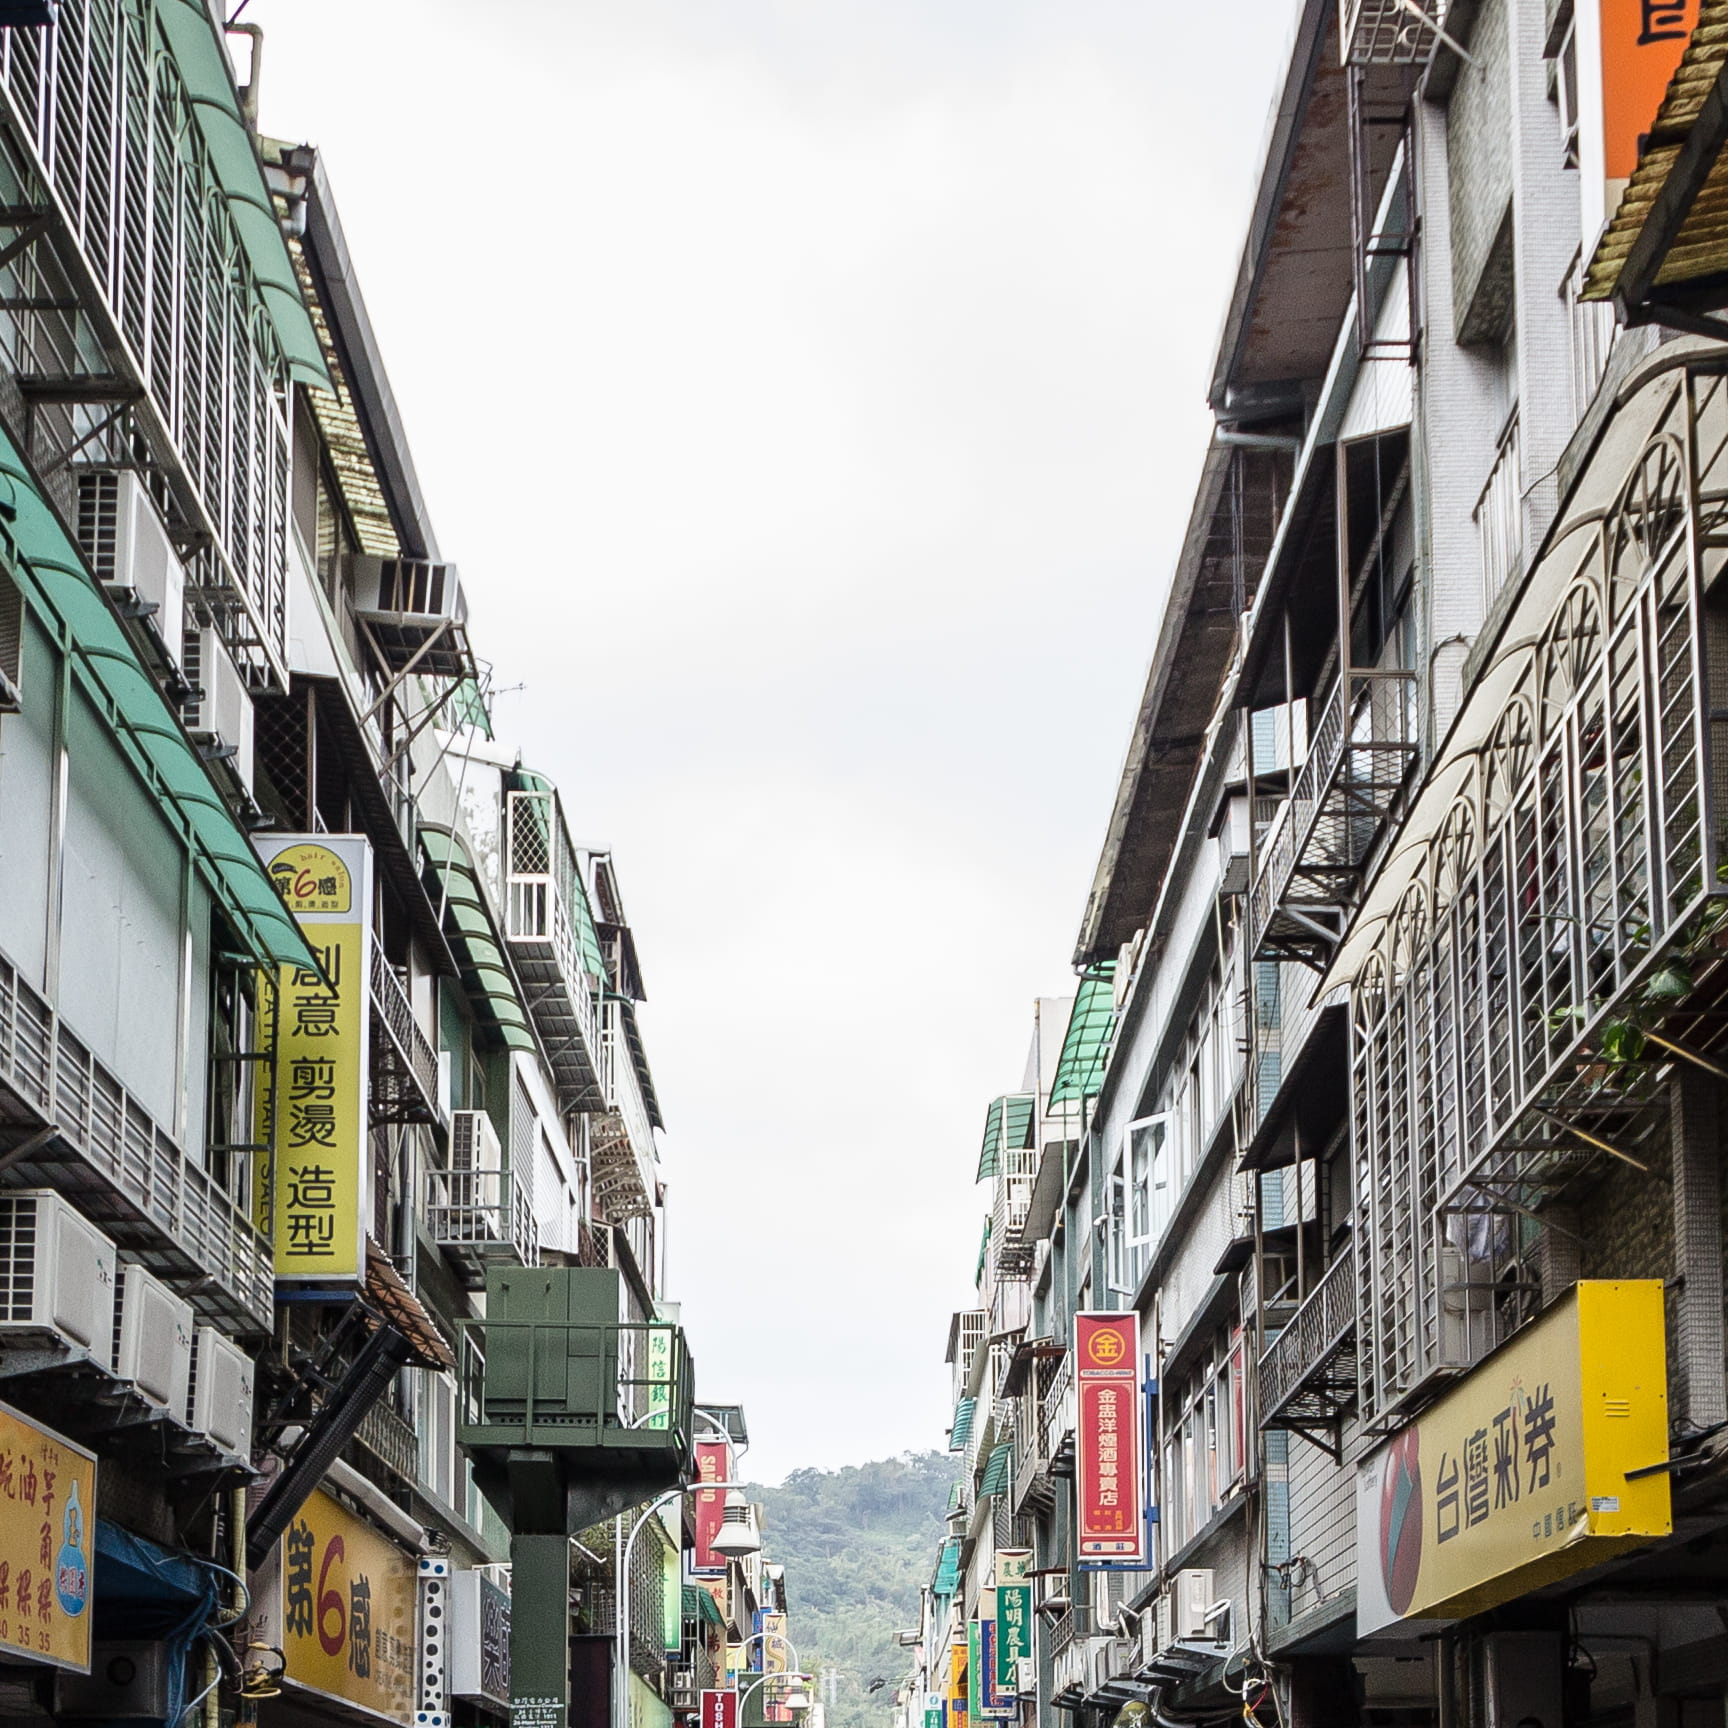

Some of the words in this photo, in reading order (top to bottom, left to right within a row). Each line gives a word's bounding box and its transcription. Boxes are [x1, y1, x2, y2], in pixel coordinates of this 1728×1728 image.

[291, 942, 341, 1037] 創意
[289, 1055, 337, 1149] 剪燙
[285, 1164, 336, 1257] 造型
[1095, 1333, 1119, 1358] 金
[1436, 1382, 1556, 1545] 台灣彩券
[17, 1624, 31, 1646] 35
[38, 1631, 51, 1652] 35
[286, 1518, 372, 1680] 第6感
